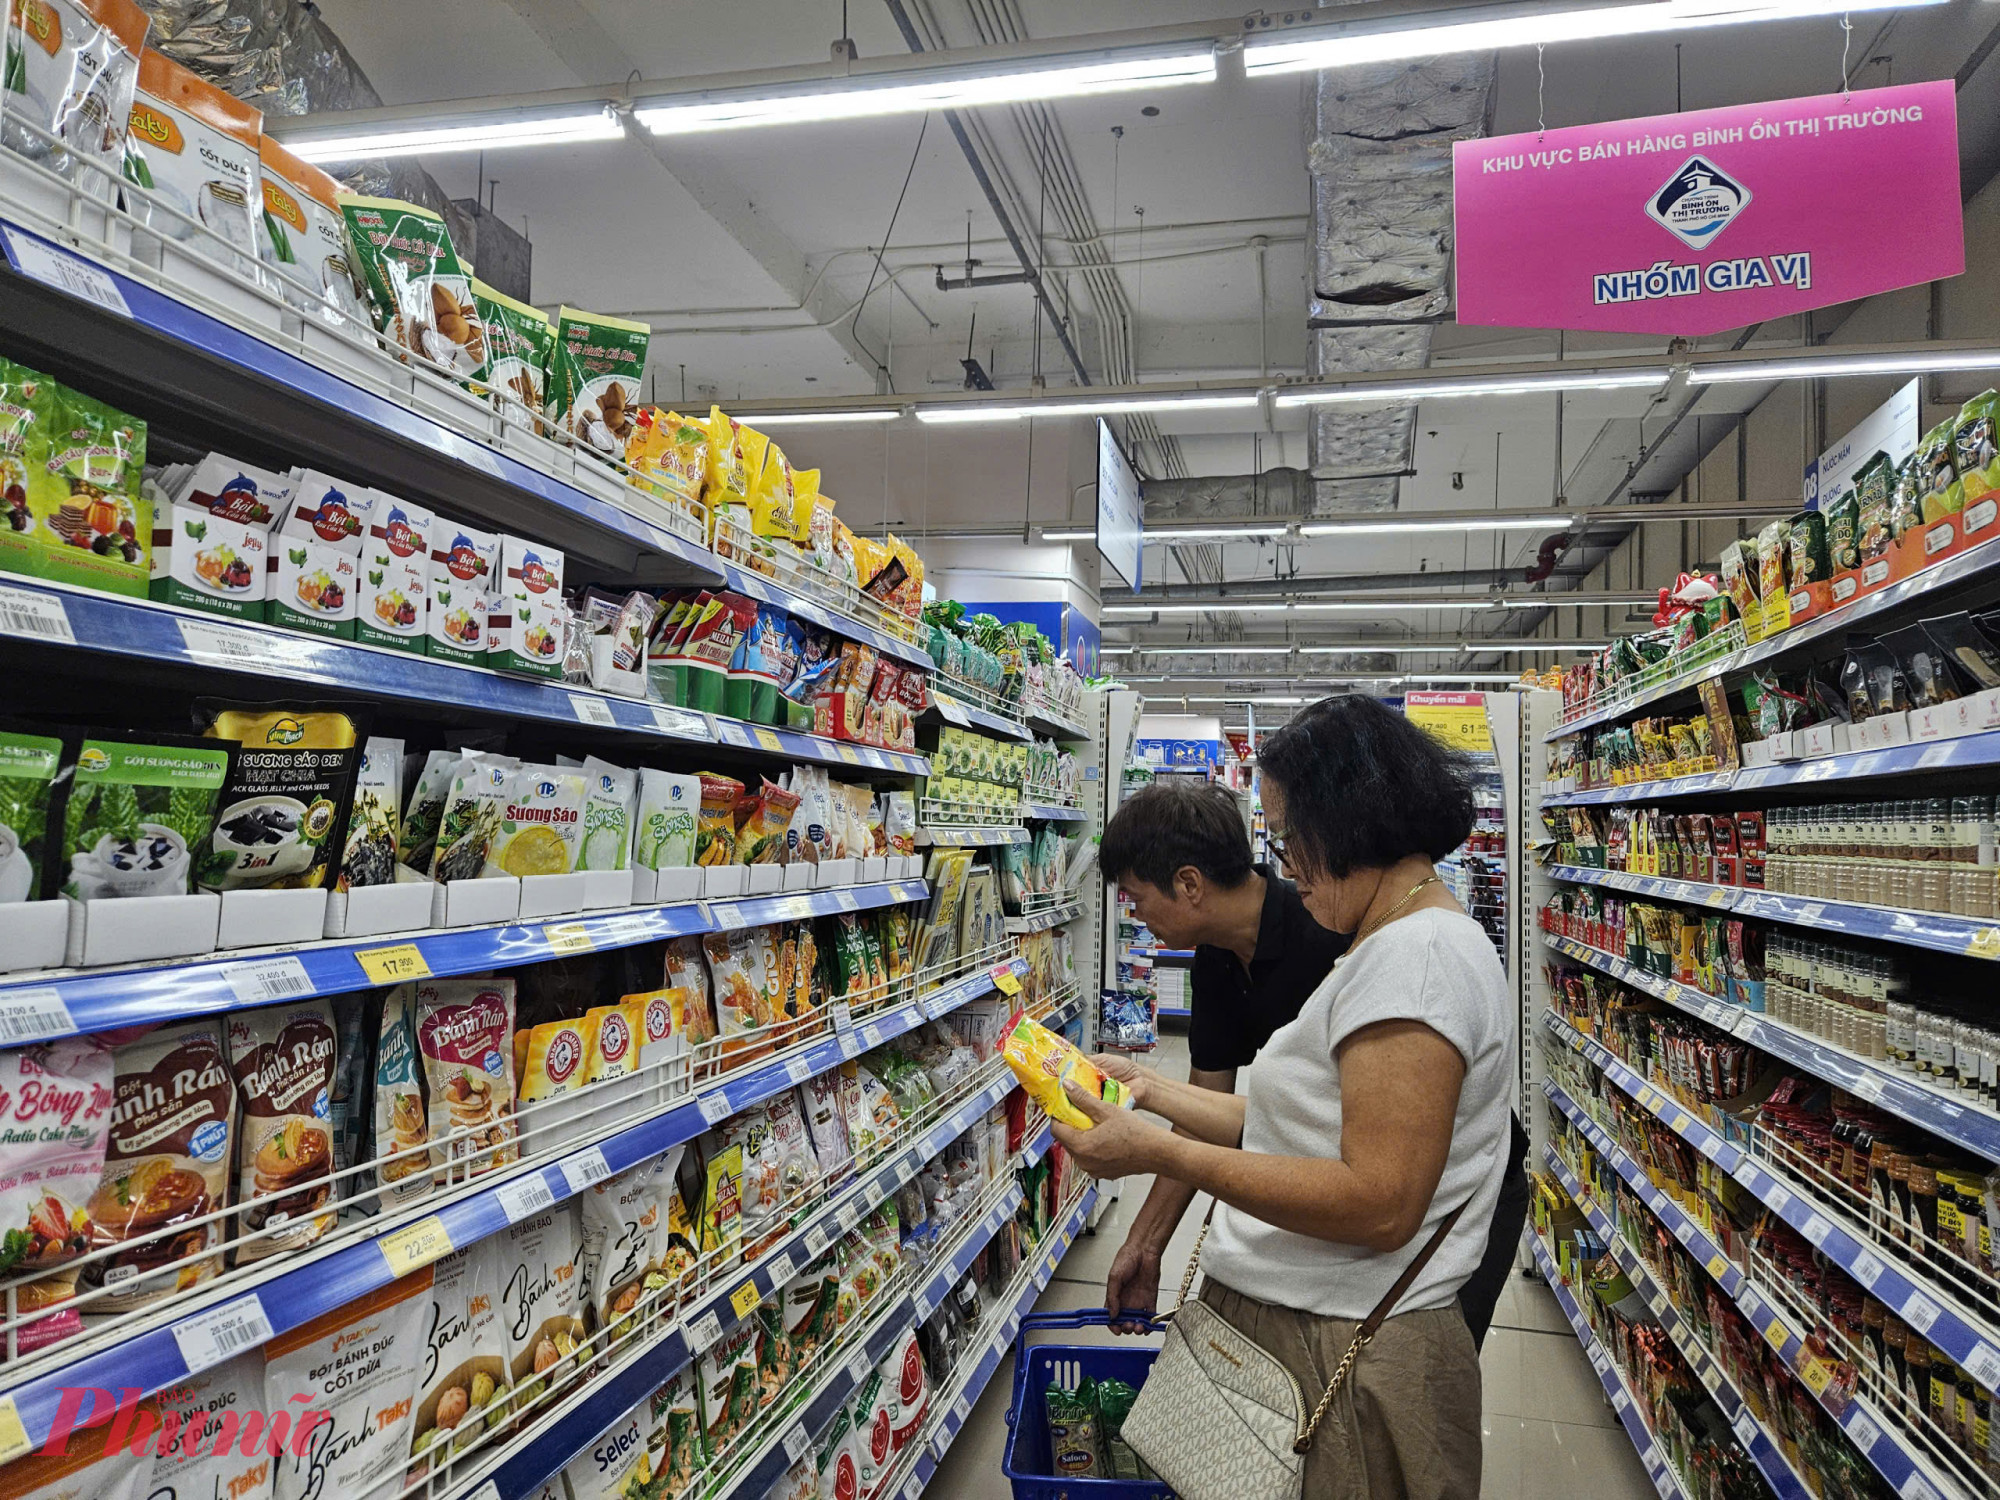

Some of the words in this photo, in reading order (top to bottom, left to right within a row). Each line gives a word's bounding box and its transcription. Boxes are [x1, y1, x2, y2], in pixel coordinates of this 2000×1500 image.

[1482, 154, 1524, 174] KHU
[1529, 149, 1573, 170] VỰC
[1578, 140, 1621, 162] BÁN
[1626, 134, 1687, 156] HÀNG
[1692, 127, 1743, 147] BÌNH
[1749, 117, 1781, 140] ỔN
[1784, 118, 1820, 137] THỊ
[1824, 105, 1923, 132] TRƯỜNG
[1681, 201, 1704, 210] BÌNH
[1596, 260, 1699, 303] NHÓM
[1706, 259, 1771, 290] GIA
[1773, 254, 1809, 288] VỊ
[48, 457, 65, 470] RAU
[1822, 451, 1837, 473] NƯỚC
[1837, 443, 1851, 461] MẮM
[1803, 472, 1817, 503] 08
[1822, 484, 1841, 506] ĐƯỜNG
[230, 498, 254, 513] Bột
[328, 511, 347, 526] Bột
[396, 528, 411, 541] Bột
[459, 554, 475, 566] Bột
[531, 569, 545, 581] Bột
[195, 595, 205, 603] 200
[297, 616, 305, 625] 200
[709, 630, 735, 647] MEIZAN
[1410, 694, 1446, 705] Khuyến
[1448, 695, 1466, 704] mãi
[1461, 724, 1475, 733] 61
[243, 753, 292, 767] SƯƠNG
[293, 750, 319, 767] SÁO
[321, 754, 344, 767] ĐEN
[245, 769, 278, 784] HẠT
[280, 769, 316, 782] CHIA
[248, 784, 269, 793] GLASS
[269, 784, 287, 793] JELLY
[286, 784, 298, 792] and
[313, 783, 330, 791] SEEDS
[506, 804, 552, 825] Sương
[552, 806, 578, 824] Sáo
[1931, 824, 1946, 834] Dh
[382, 959, 398, 976] 17
[482, 1007, 505, 1029] Rán
[548, 1045, 558, 1065] ARM
[239, 1053, 291, 1101] Bánh
[291, 1035, 334, 1070] Rán
[608, 1063, 622, 1075] pure
[171, 1057, 227, 1099] Rán
[118, 1079, 141, 1098] Bột
[553, 1084, 567, 1096] pure
[14, 1080, 85, 1126] Bông
[134, 1110, 159, 1130] Pha
[160, 1099, 183, 1117] sẵn
[39, 1126, 66, 1142] Cake
[191, 1141, 203, 1155] 1
[201, 1126, 228, 1147] PHÚT
[537, 1216, 552, 1229] BAO
[404, 1240, 423, 1260] 22
[503, 1263, 556, 1341] Bánh
[309, 1363, 334, 1381] BỘT
[335, 1346, 369, 1371] BÁNH
[372, 1335, 395, 1355] ĐÚC
[324, 1371, 354, 1394] CỐT
[357, 1358, 382, 1380] DỪA
[164, 1407, 204, 1432] BÁNH
[208, 1391, 237, 1413] ĐÚC
[375, 1395, 414, 1432] Taky
[192, 1417, 224, 1442] DỪA
[594, 1420, 640, 1472] Select
[1061, 1454, 1088, 1463] Safoco
[227, 1459, 270, 1500] Taky
